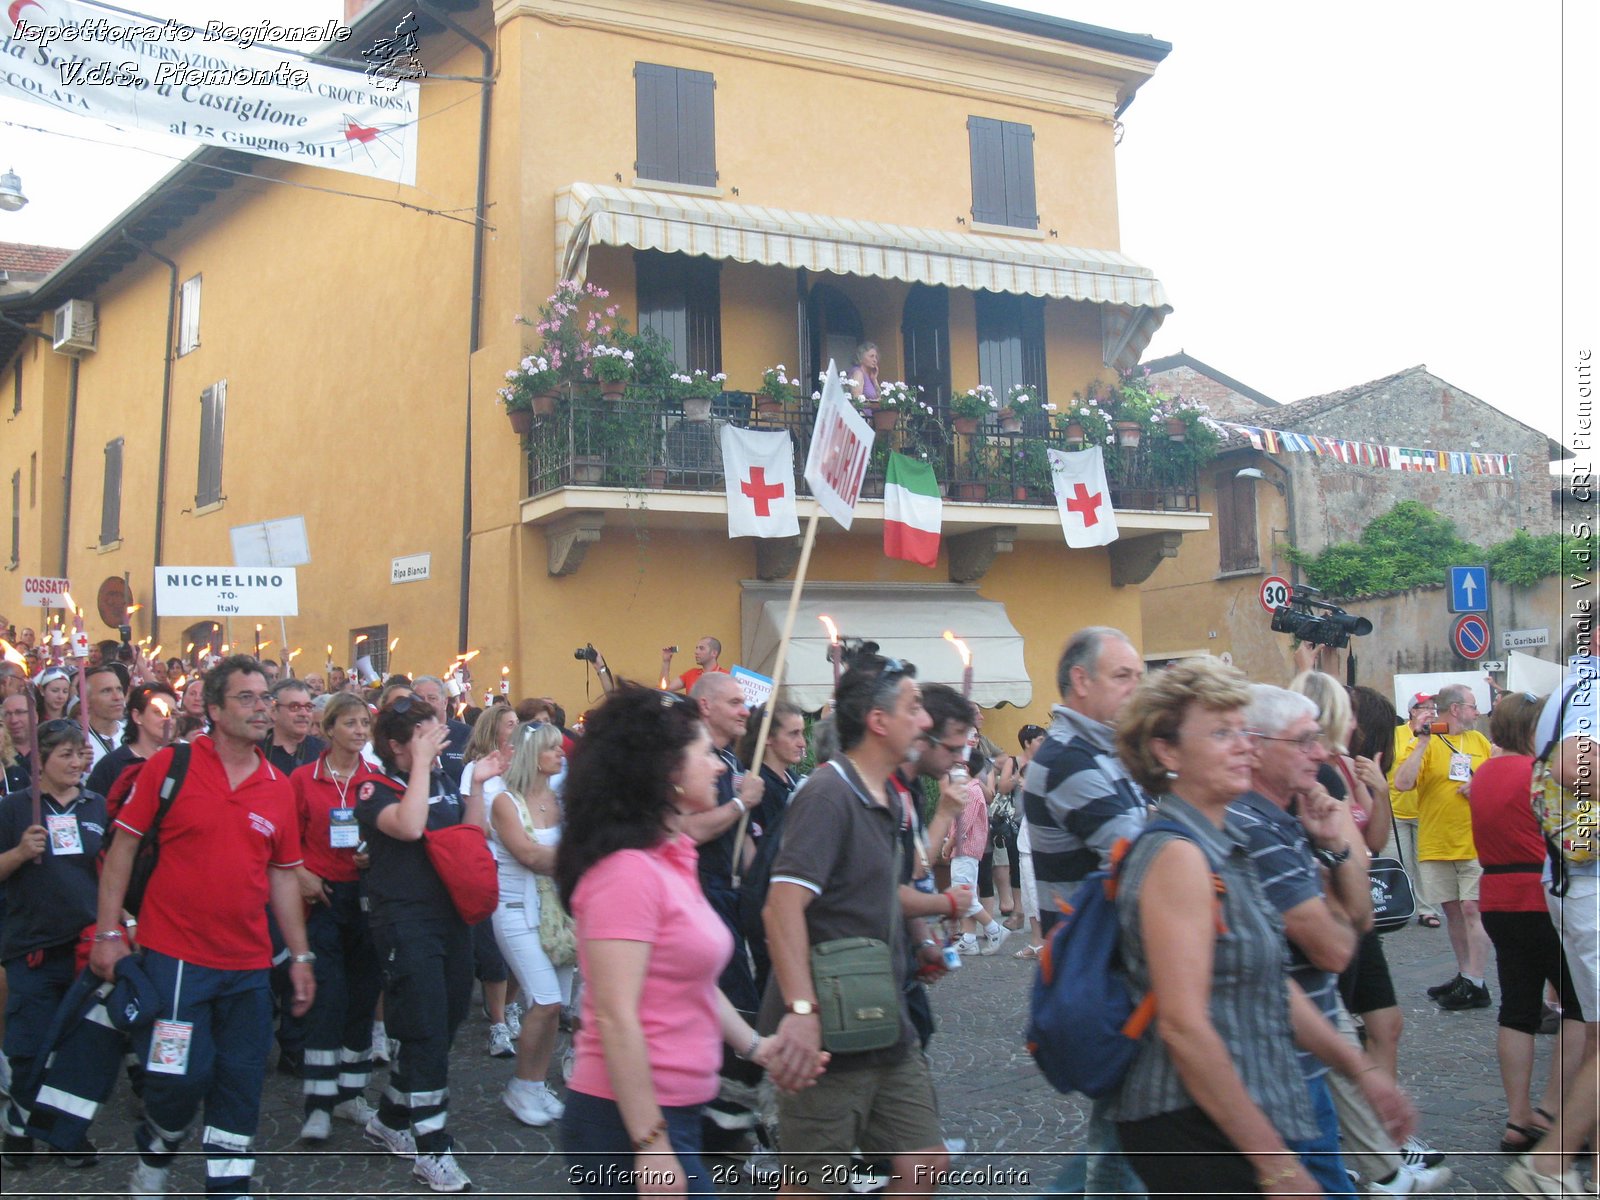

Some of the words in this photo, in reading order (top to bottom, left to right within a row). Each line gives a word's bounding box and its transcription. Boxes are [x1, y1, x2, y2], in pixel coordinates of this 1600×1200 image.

[121, 35, 260, 80] INTERNAZION
[318, 83, 366, 105] CROCE
[369, 94, 412, 113] ROSSA
[0, 69, 91, 110] COLATA
[181, 83, 308, 128] Castiglione
[169, 120, 187, 135] al
[194, 124, 215, 138] 25
[222, 130, 290, 152] Giugno
[296, 141, 336, 158] 2011
[167, 574, 283, 587] NICHELINO
[394, 569, 406, 579] Ripa
[407, 566, 427, 577] Bianca
[25, 578, 70, 594] COSSATO
[217, 591, 238, 599] -TO-
[1265, 586, 1286, 604] 30
[217, 604, 240, 613] Italy
[1504, 638, 1513, 646] G.
[1513, 635, 1546, 646] Garibaldi
